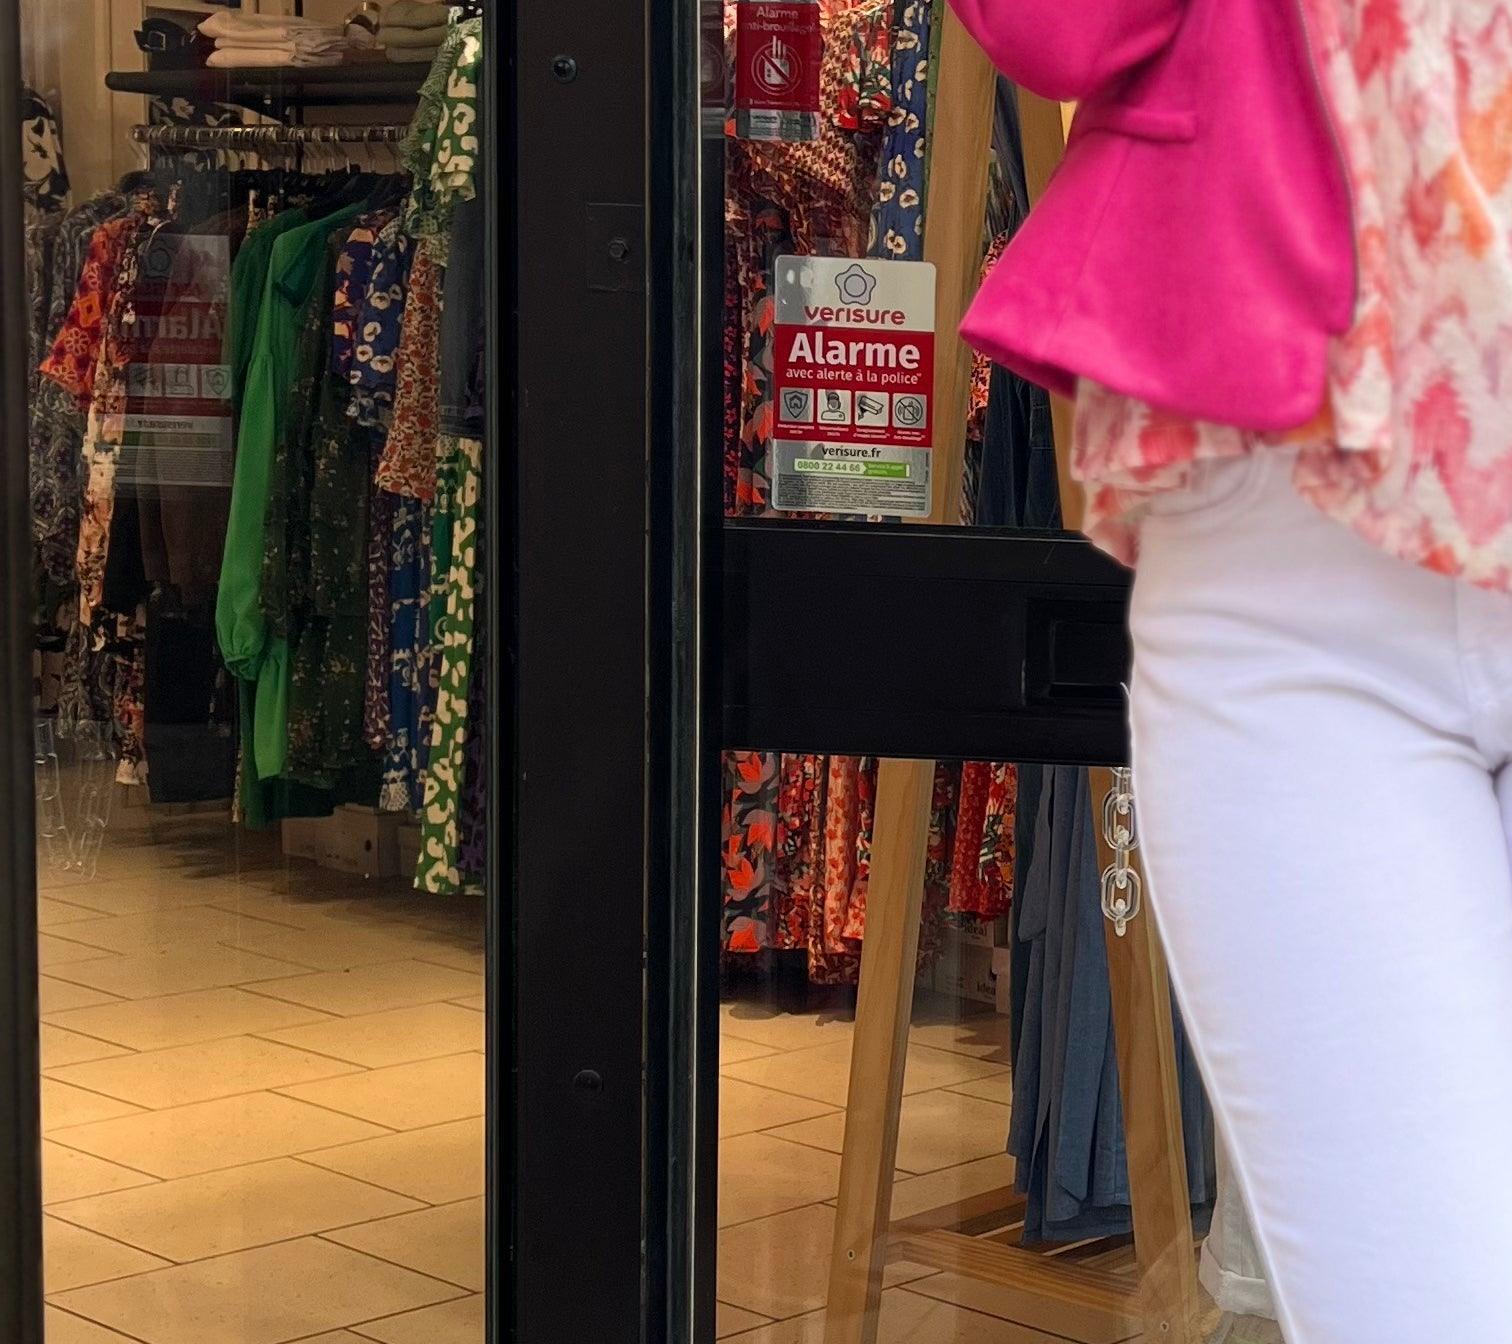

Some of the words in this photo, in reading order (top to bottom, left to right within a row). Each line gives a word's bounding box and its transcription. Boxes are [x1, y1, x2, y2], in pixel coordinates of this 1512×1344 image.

[756, 6, 799, 19] Alarme
[804, 306, 906, 325] verisure
[788, 331, 920, 369] Alarme
[786, 368, 814, 379] avec
[816, 368, 853, 381] alerte
[856, 369, 863, 382] à
[866, 370, 878, 383] la
[822, 445, 881, 459] verisure.fr
[797, 460, 820, 471] 0800
[822, 462, 834, 471] 22
[836, 463, 848, 472] 44
